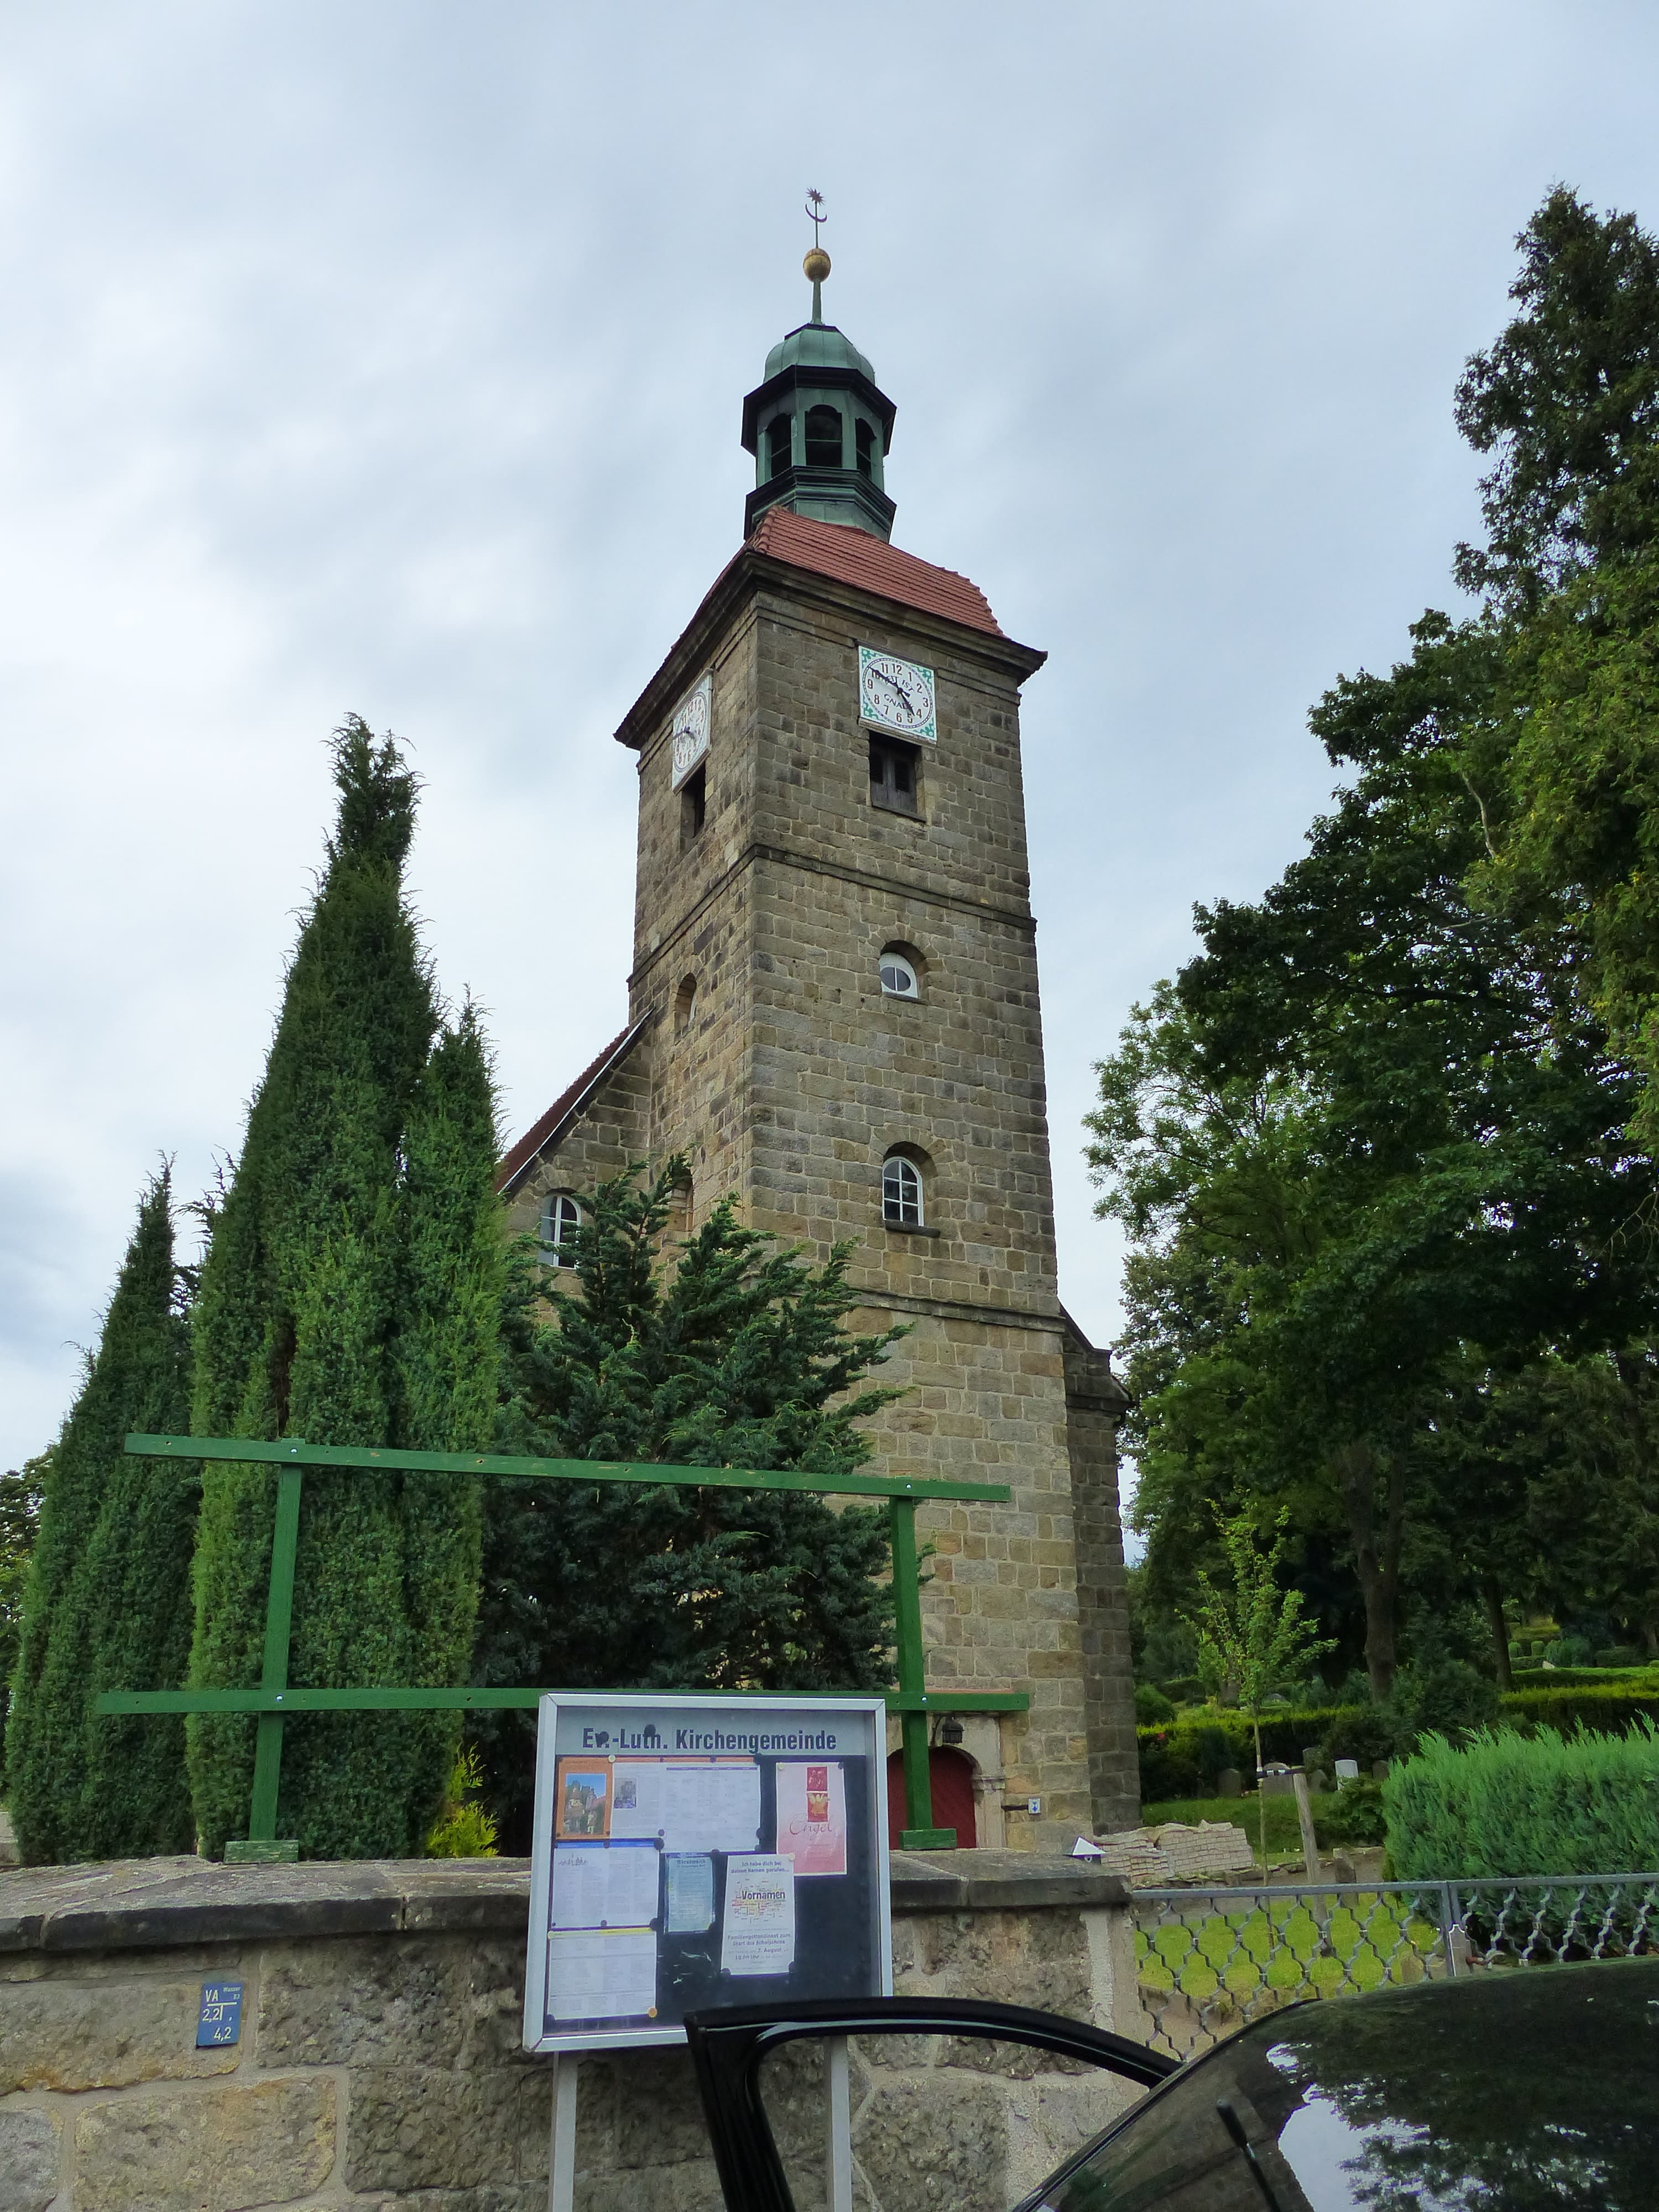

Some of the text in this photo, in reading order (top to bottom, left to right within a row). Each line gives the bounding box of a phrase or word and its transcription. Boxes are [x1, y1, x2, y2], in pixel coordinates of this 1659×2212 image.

[881, 662, 888, 674] 11
[892, 664, 902, 675] 12
[908, 671, 912, 682] 1
[867, 679, 873, 689] 9
[902, 680, 914, 691] IST
[916, 683, 922, 693] 2
[874, 694, 880, 705] 8
[922, 697, 928, 707] 3
[883, 705, 889, 715] 7
[916, 708, 922, 718] 4
[896, 712, 902, 723] 6
[907, 712, 913, 723] 5
[676, 1729, 837, 1754] Kirchengemeinde
[742, 1891, 785, 1900] Vornamen
[205, 1989, 218, 2002] VA
[202, 2008, 220, 2023] 2,2
[213, 2027, 232, 2042] 4,2
